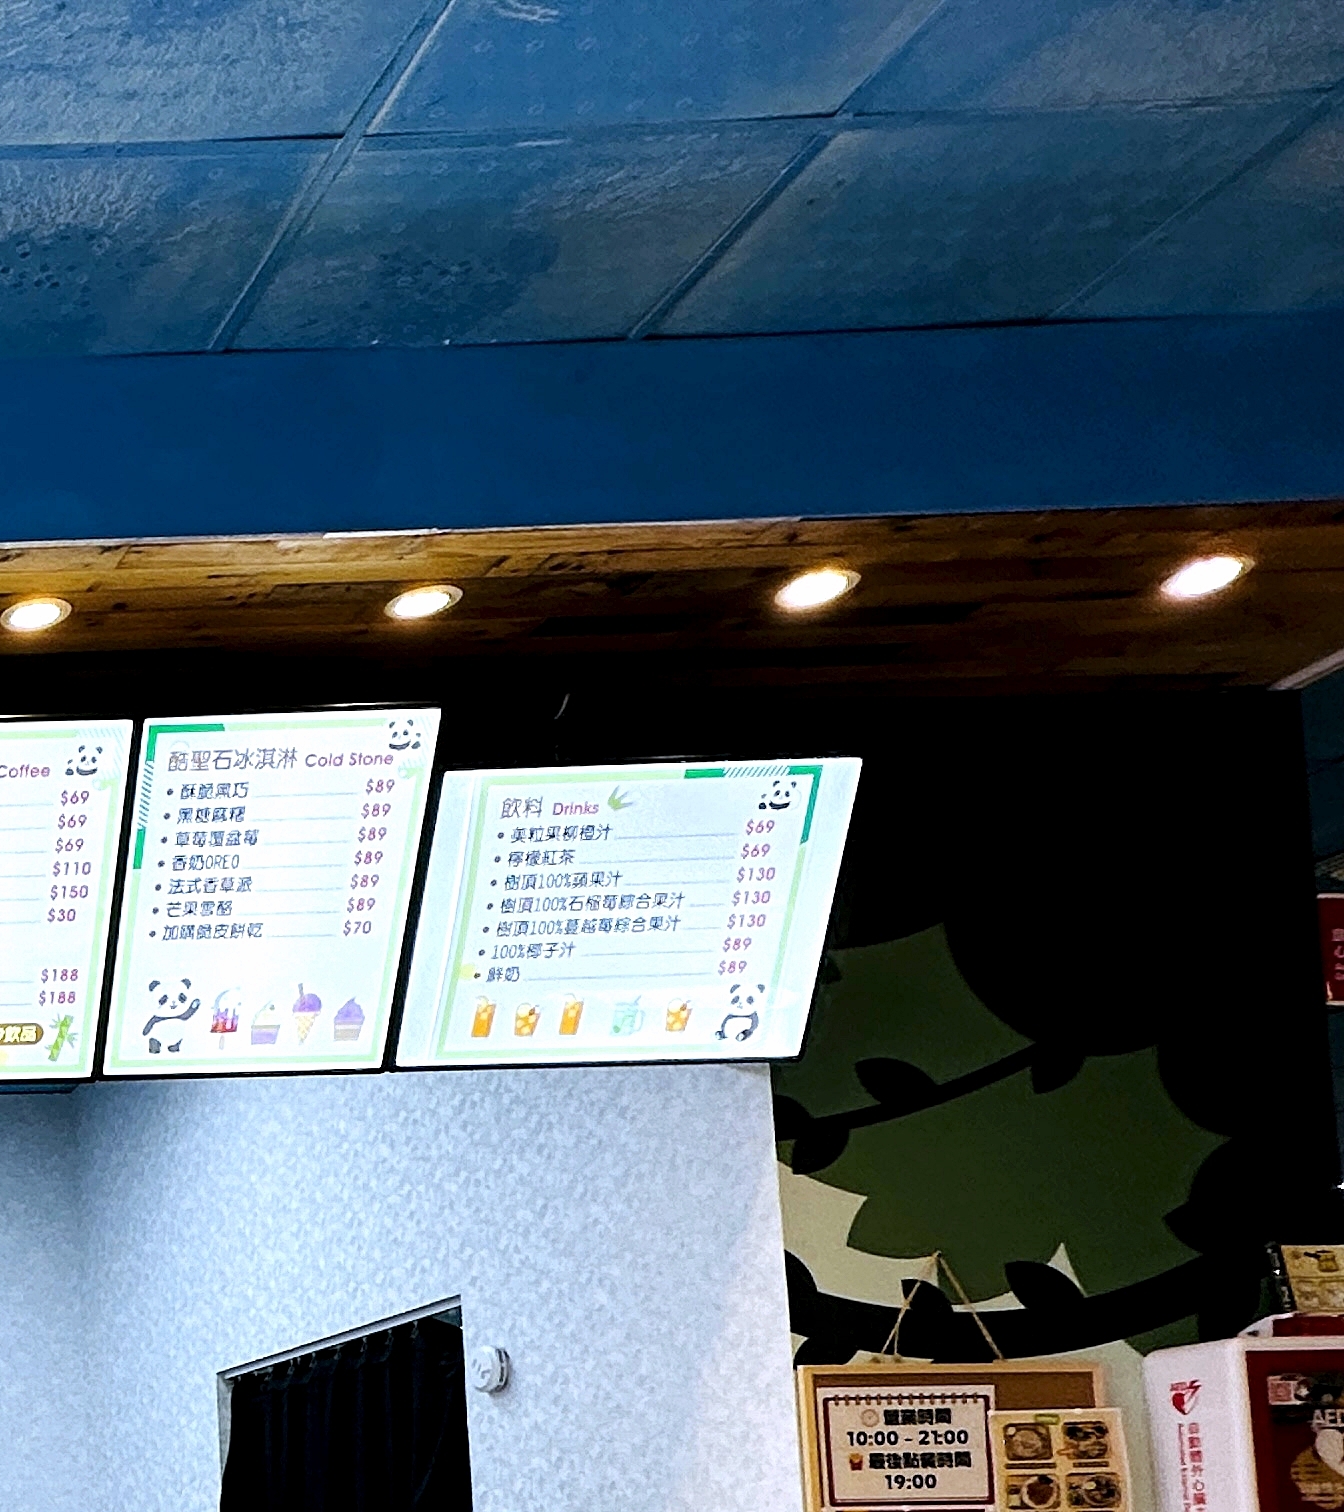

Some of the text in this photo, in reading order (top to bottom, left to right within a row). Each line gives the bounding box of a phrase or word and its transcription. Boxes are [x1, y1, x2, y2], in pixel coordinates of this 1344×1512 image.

[168, 747, 394, 772] 酷聖石冰淇淋 Cold Stone
[365, 779, 396, 795] $89
[61, 790, 90, 805] $69
[361, 804, 391, 819] $89
[500, 796, 600, 819] 飲料 Drinks
[58, 814, 87, 829] $69
[745, 819, 776, 835] $69
[358, 828, 387, 843] $89
[55, 838, 84, 852] $69
[740, 843, 771, 860] $69
[354, 851, 384, 866] $89
[53, 861, 92, 877] $110
[736, 867, 776, 883] $130
[350, 874, 380, 890] $89
[50, 884, 89, 900] $150
[731, 890, 771, 906] $130
[347, 898, 376, 913] $89
[47, 908, 77, 924] $30
[726, 914, 767, 929] $130
[343, 921, 372, 937] $70
[722, 936, 752, 953] $89
[41, 968, 79, 983] $188
[717, 960, 747, 976] $89
[39, 991, 76, 1006] $188
[847, 1429, 969, 1446] 10:00 21:00
[884, 1474, 937, 1489] 19:00
